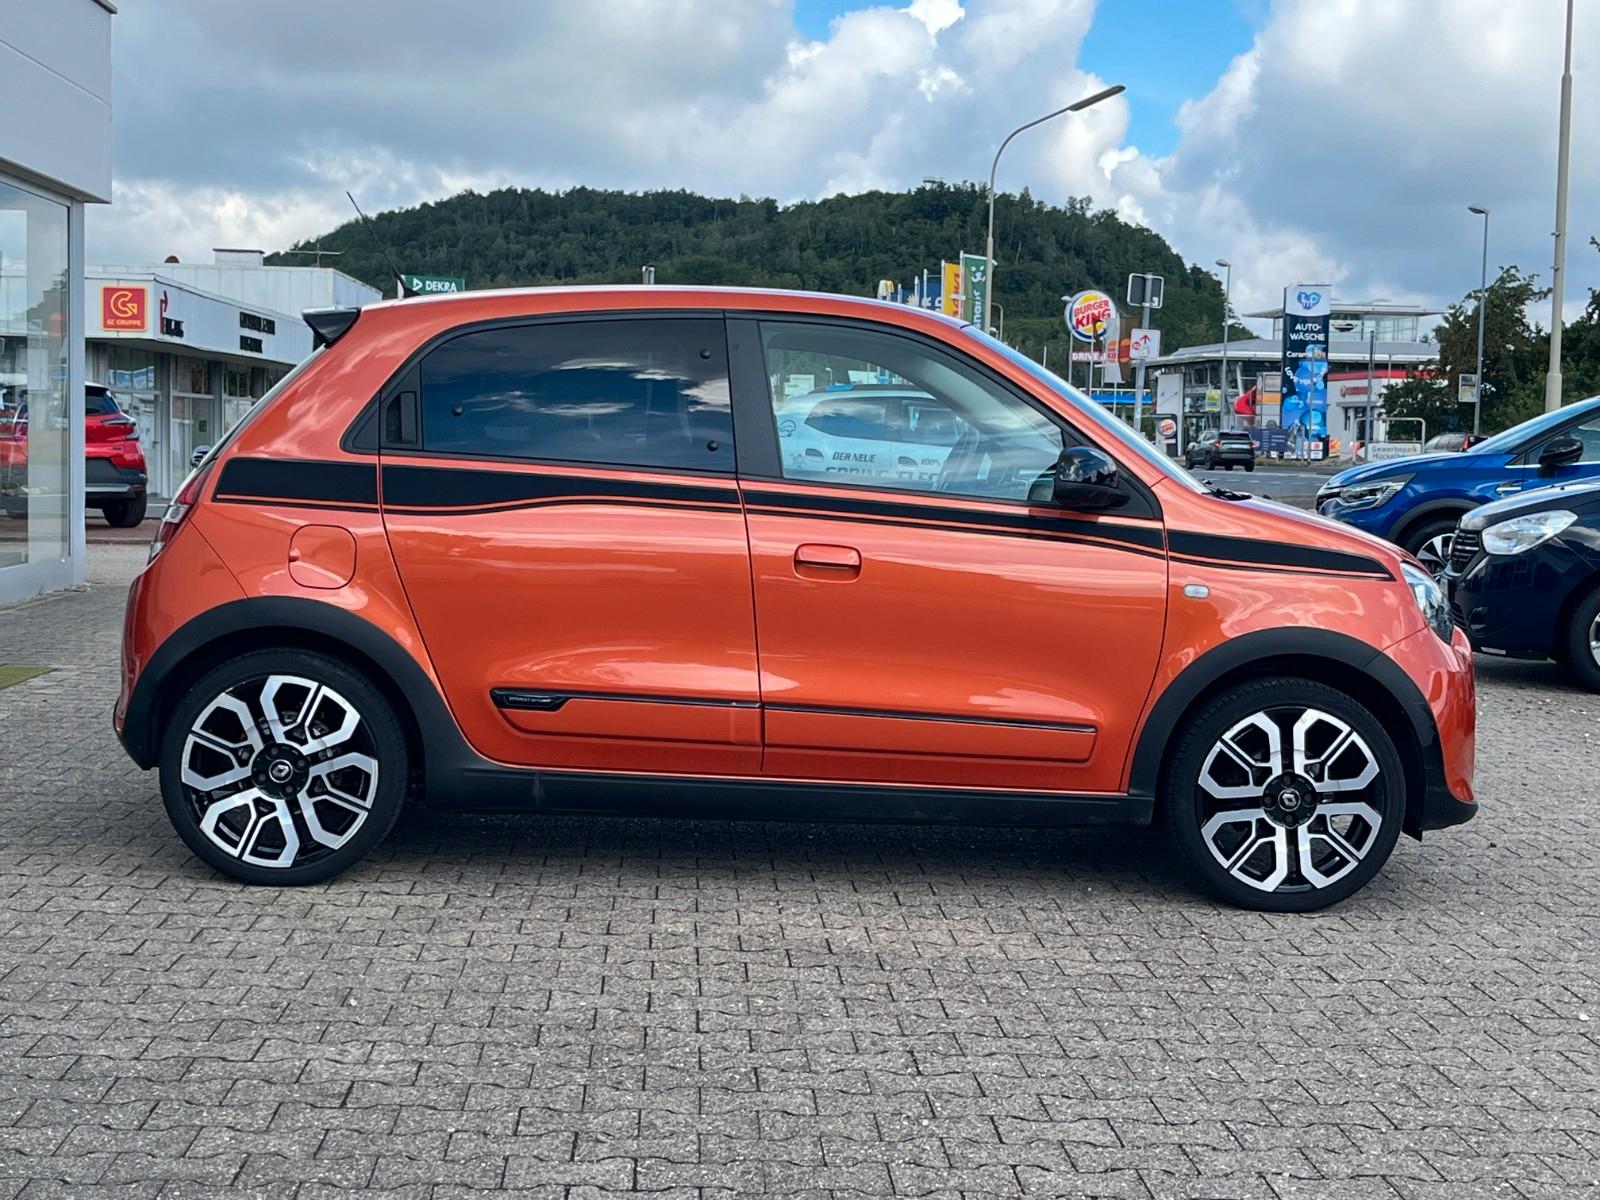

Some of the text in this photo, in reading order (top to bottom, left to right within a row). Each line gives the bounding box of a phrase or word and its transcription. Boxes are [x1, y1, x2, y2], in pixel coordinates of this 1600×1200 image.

[425, 280, 457, 293] DEKRA
[1074, 300, 1109, 317] BURGER
[1075, 309, 1111, 329] KING
[1294, 323, 1321, 331] AUTO-
[1289, 332, 1326, 341] WÄSCHE
[832, 451, 850, 461] DER
